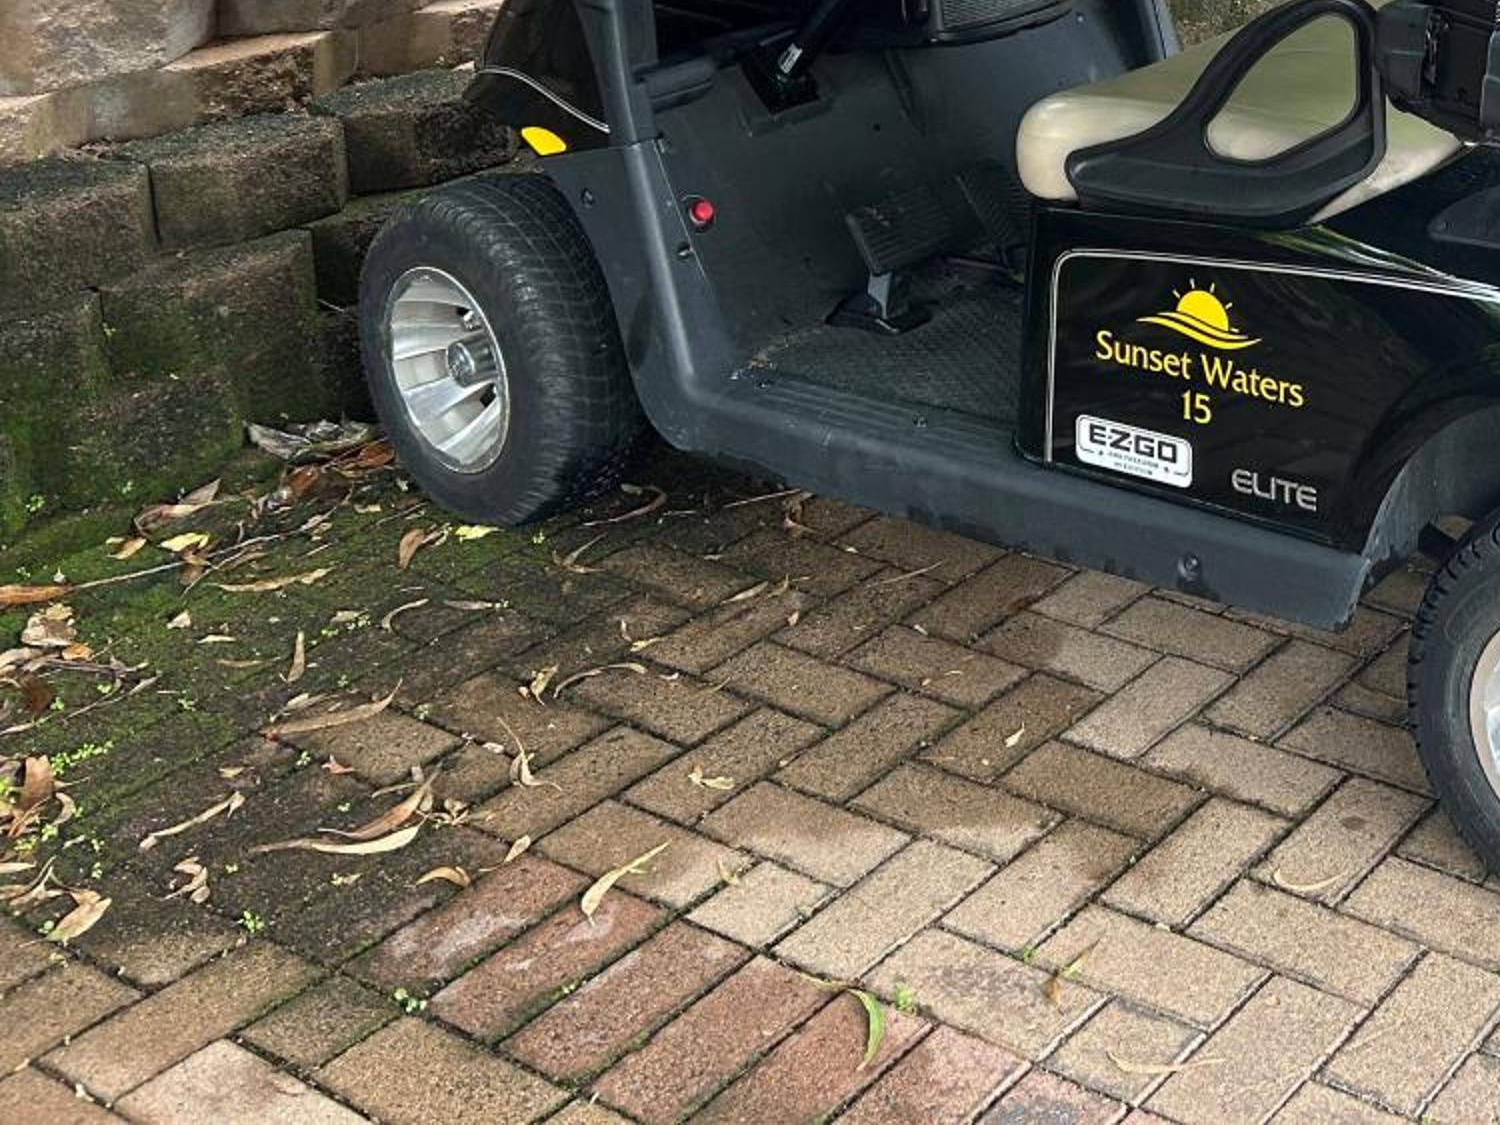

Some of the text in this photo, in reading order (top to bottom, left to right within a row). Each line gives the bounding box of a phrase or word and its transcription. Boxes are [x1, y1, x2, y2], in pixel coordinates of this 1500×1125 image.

[1095, 330, 1305, 408] Sunset Waters
[1181, 389, 1213, 425] 15
[1232, 469, 1317, 511] ELITE
